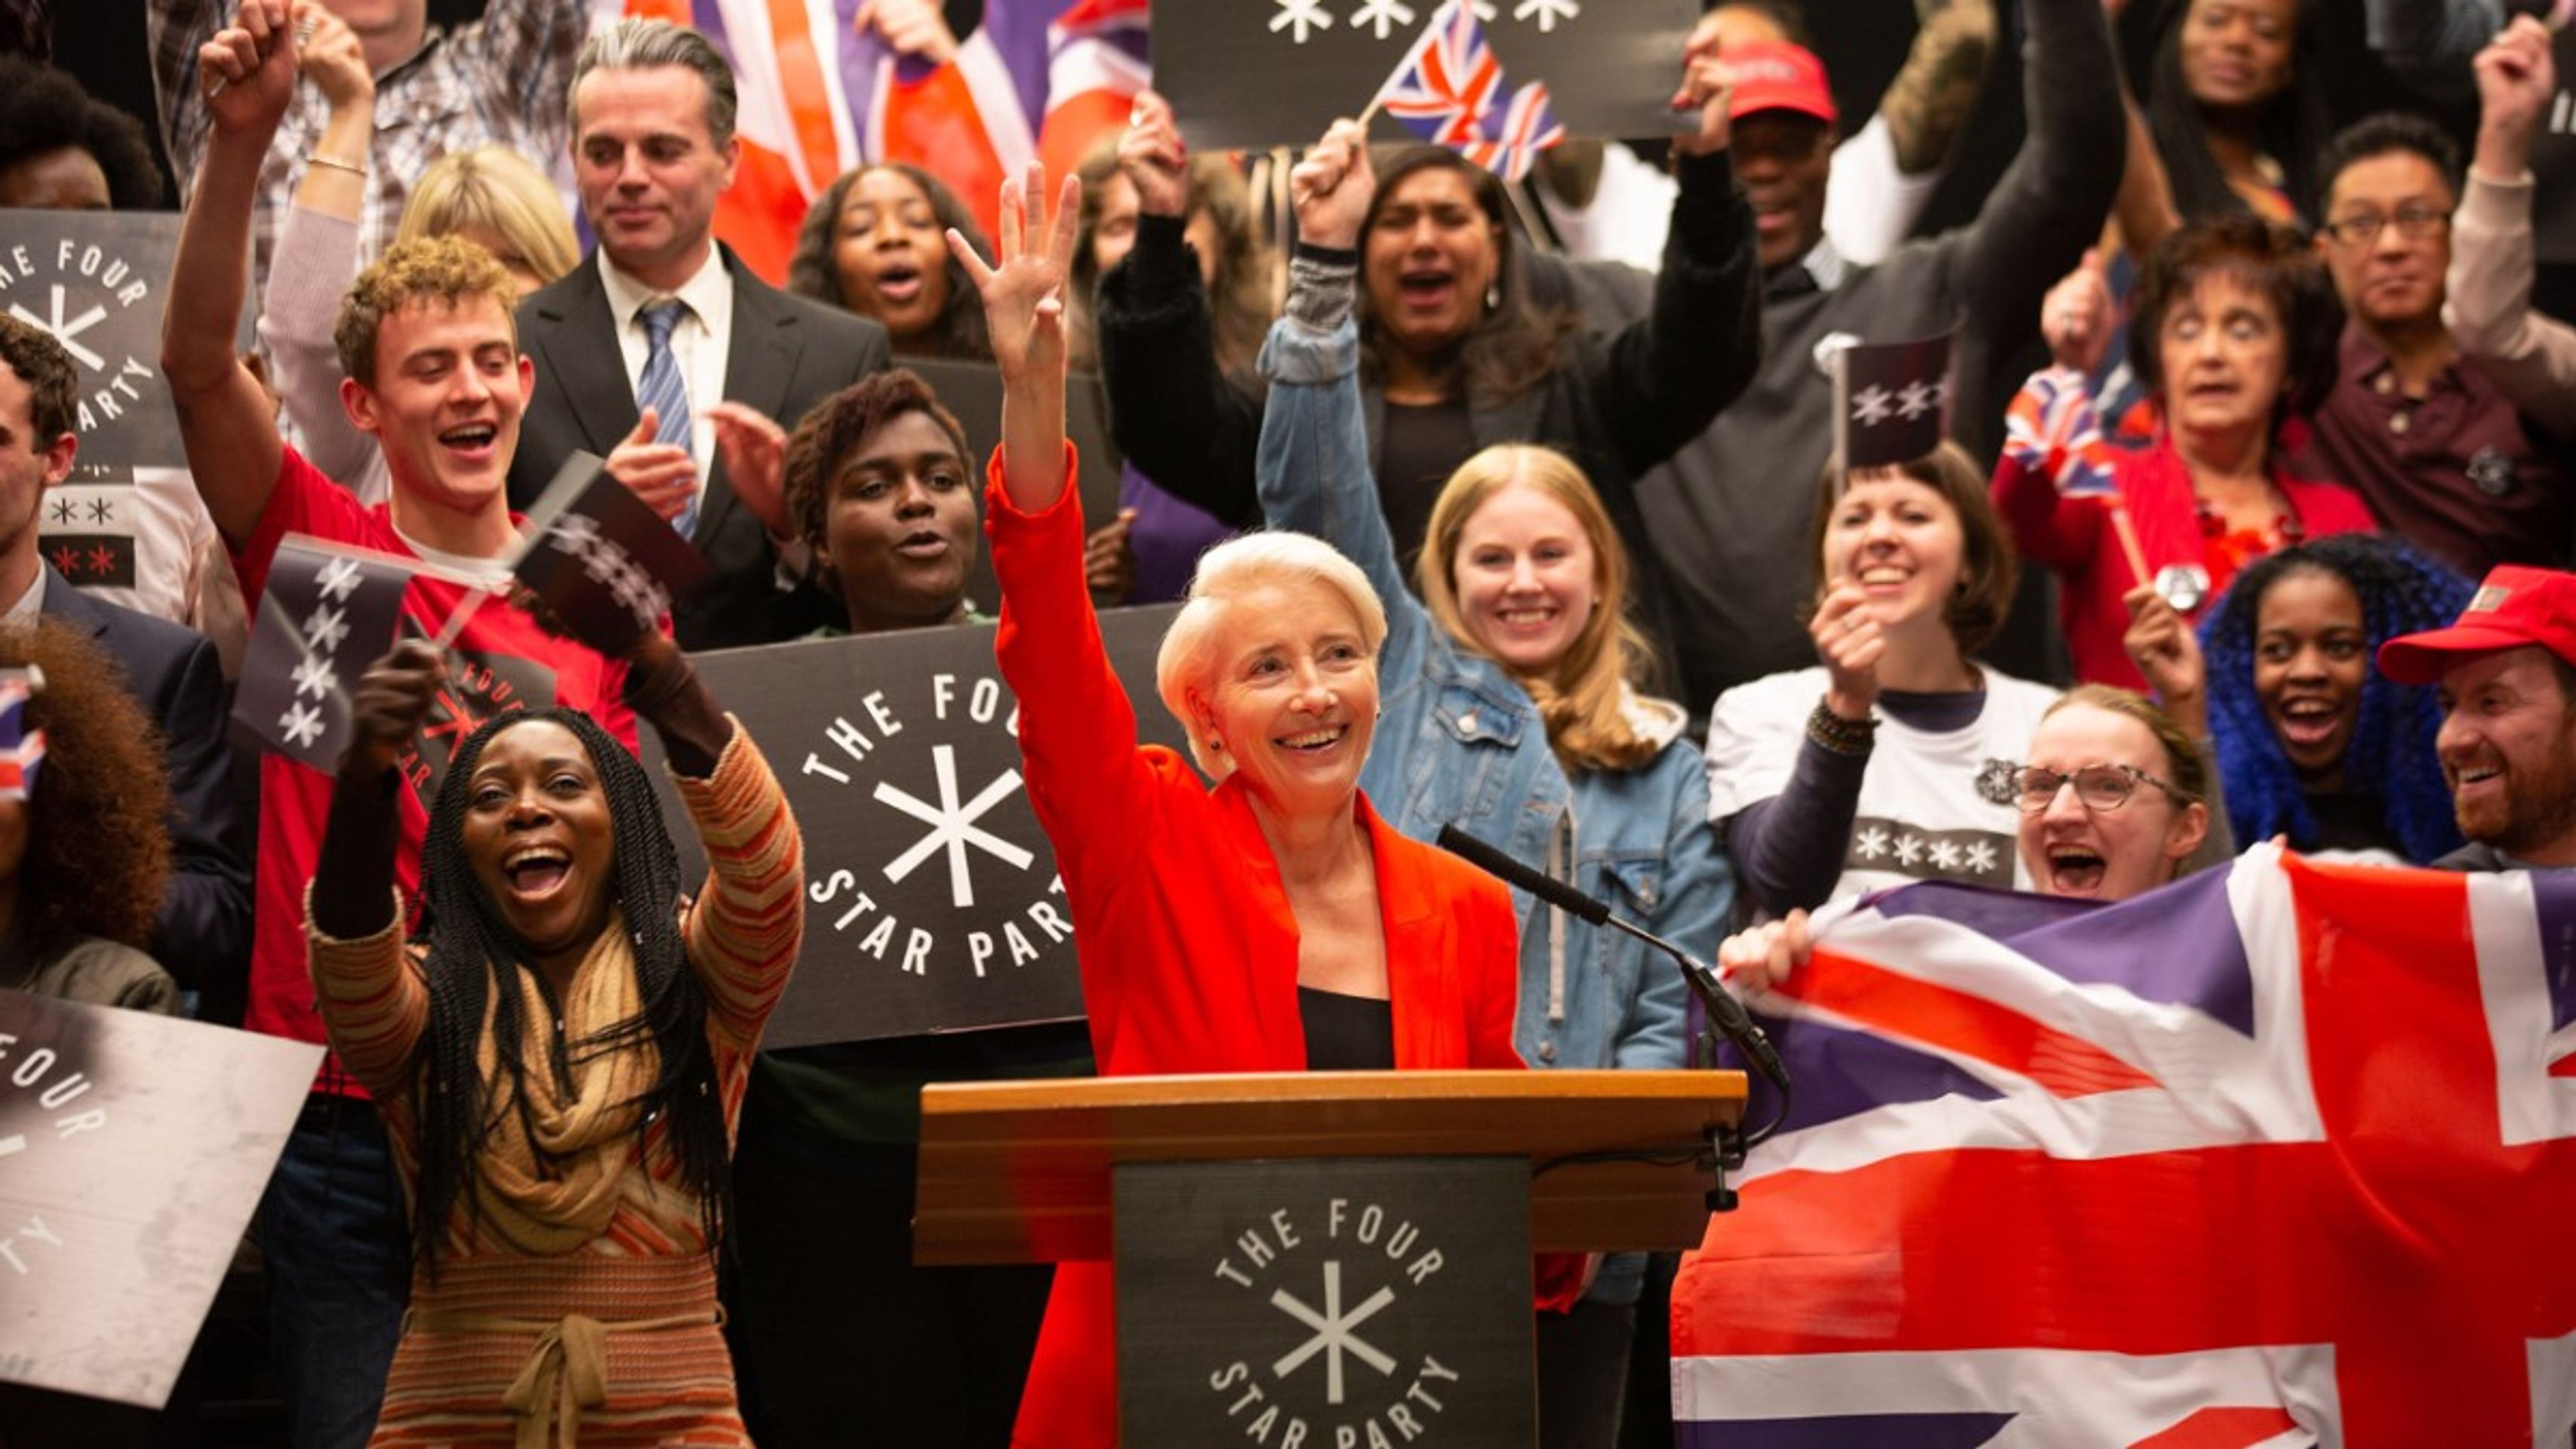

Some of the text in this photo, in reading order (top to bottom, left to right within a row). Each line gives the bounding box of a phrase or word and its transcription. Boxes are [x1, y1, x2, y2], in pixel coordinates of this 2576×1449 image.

[57, 239, 147, 307] FOUR
[76, 355, 153, 432] ARTY
[802, 673, 1020, 783] THE FO
[809, 869, 933, 976] STAR
[1214, 1199, 1444, 1287] THE FOUR
[1209, 1355, 1459, 1449] STAR PARTY
